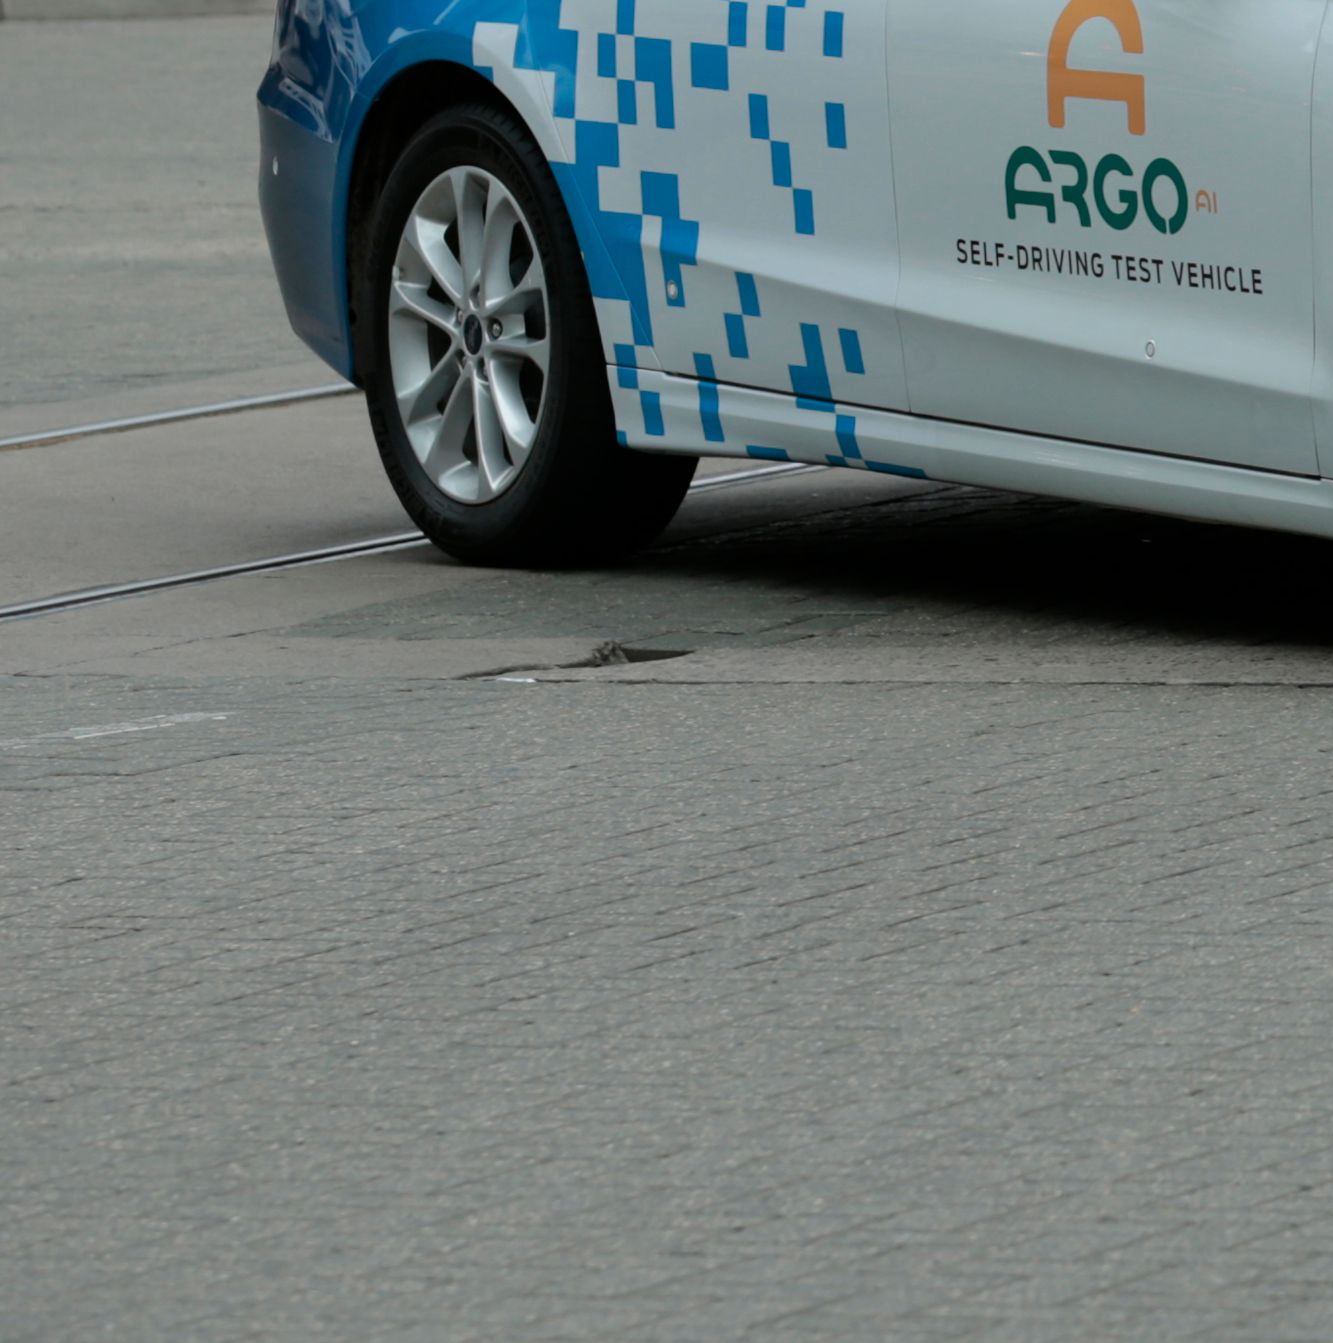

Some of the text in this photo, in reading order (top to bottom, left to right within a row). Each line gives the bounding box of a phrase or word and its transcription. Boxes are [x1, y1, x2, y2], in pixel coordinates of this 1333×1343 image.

[1004, 145, 1189, 235] ARGO
[956, 238, 1264, 295] SELF-DRIVING TEST VEHICLE
